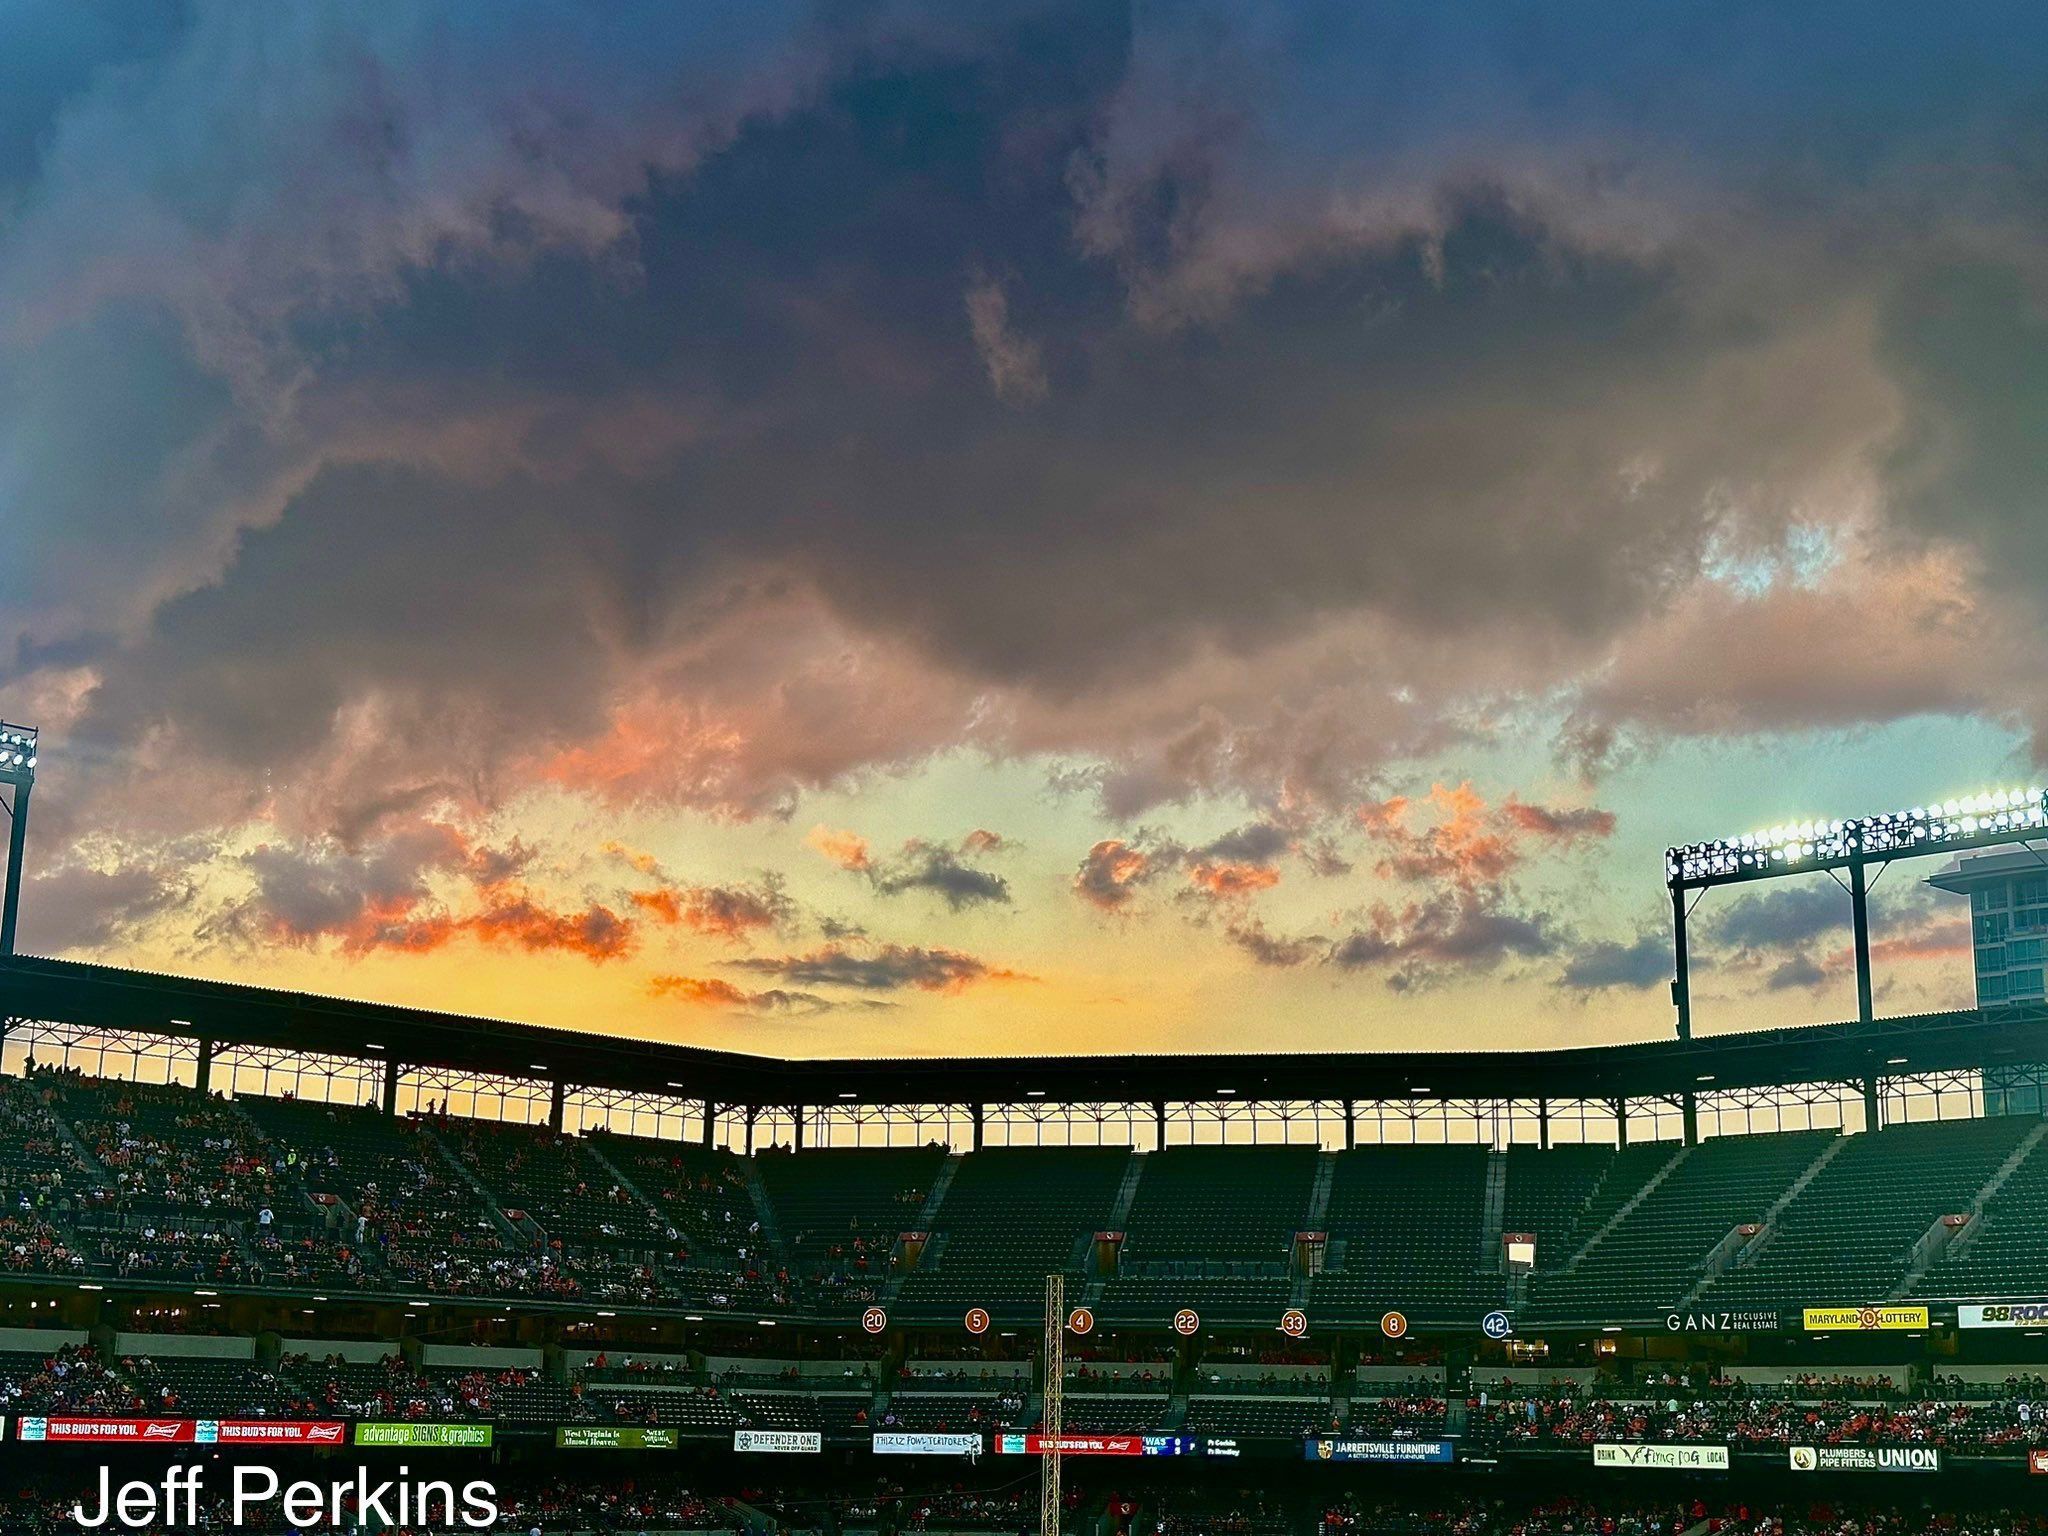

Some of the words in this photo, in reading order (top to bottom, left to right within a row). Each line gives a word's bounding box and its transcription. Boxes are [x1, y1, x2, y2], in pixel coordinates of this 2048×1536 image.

[866, 1314, 882, 1327] 20
[973, 1314, 980, 1328] 5
[1076, 1314, 1084, 1328] 4
[1178, 1315, 1194, 1328] 22
[1667, 1314, 1731, 1330] GANZ
[1733, 1312, 1777, 1320] EXCLUSIVE
[1809, 1314, 1858, 1324] MARYLAND
[1880, 1313, 1922, 1323] LOTTERY
[1286, 1316, 1302, 1330] 33
[1390, 1318, 1398, 1331] 8
[1486, 1318, 1504, 1332] 42
[1733, 1322, 1750, 1330] REAL
[1753, 1321, 1778, 1330] ESTATE
[51, 1423, 72, 1434] THIS
[72, 1424, 98, 1434] BUD'S
[100, 1424, 119, 1434] FOR
[120, 1424, 138, 1436] YOU.
[222, 1426, 242, 1437] THIS
[242, 1426, 266, 1437] BUD'S
[267, 1427, 282, 1437] FOR
[284, 1427, 302, 1437] YOU.
[364, 1425, 410, 1444] advantage
[412, 1426, 439, 1442] SIGNS
[583, 1430, 612, 1438] Virginia
[641, 1434, 672, 1444] VIRGINIA
[754, 1434, 798, 1444] DEFENDER
[800, 1435, 818, 1446] ONE
[876, 1436, 894, 1445] THIZ
[1075, 1441, 1088, 1449] FOR
[1146, 1438, 1166, 1446] WAS
[1146, 1446, 1158, 1455] TB
[1336, 1442, 1394, 1454] JARRETTSVILLE
[1396, 1444, 1440, 1454] FURNITURE
[1820, 1448, 1866, 1458] PLUMBERS
[1597, 1450, 1616, 1460] DRINK
[1706, 1452, 1726, 1463] LOCAL
[1878, 1448, 1938, 1467] UNION
[1820, 1458, 1840, 1467] PIPE
[1841, 1458, 1876, 1468] FITTERS
